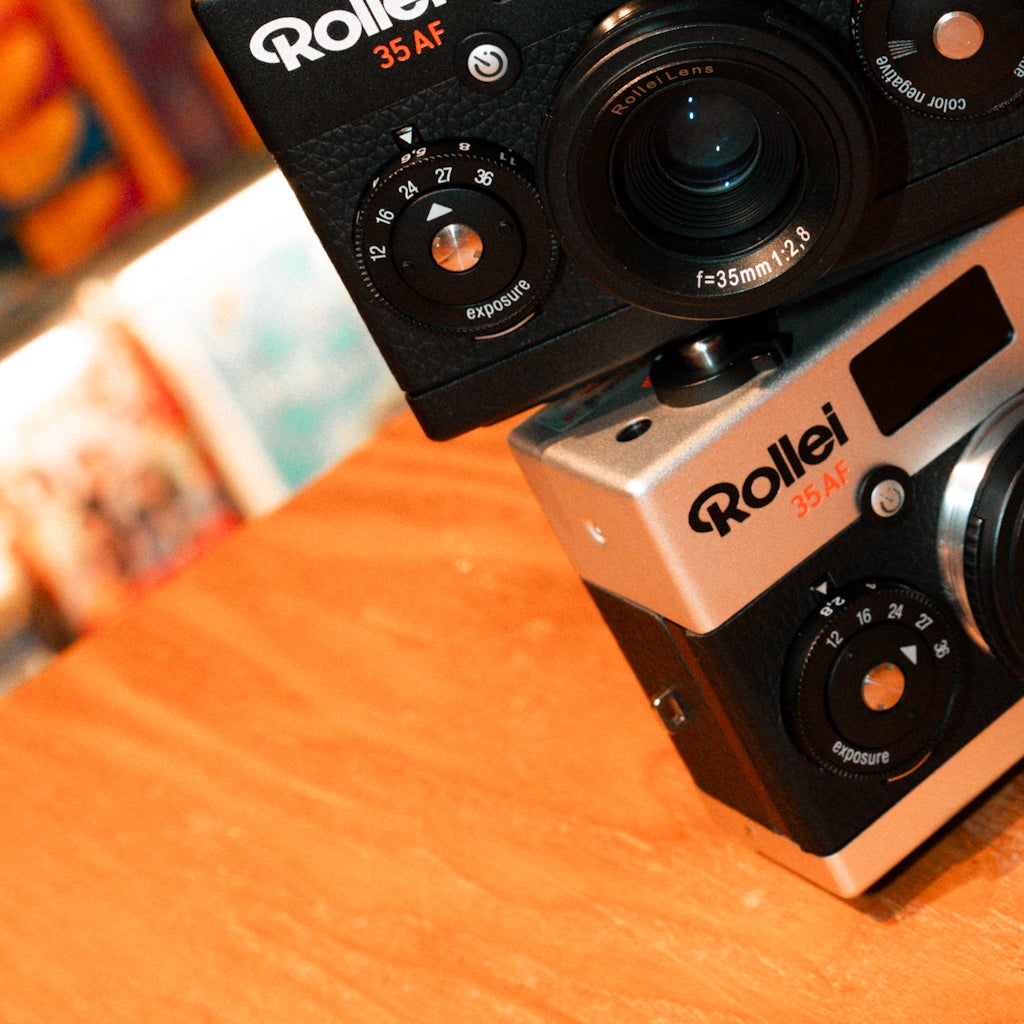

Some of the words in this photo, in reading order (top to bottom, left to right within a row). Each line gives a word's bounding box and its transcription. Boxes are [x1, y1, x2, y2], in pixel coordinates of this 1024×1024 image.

[372, 37, 412, 69] 35
[413, 20, 445, 55] AF
[875, 56, 926, 104] negative
[926, 96, 967, 113] color
[459, 142, 471, 152] 8
[435, 167, 453, 184] 27
[474, 169, 495, 186] 36
[398, 180, 419, 200] 24
[375, 208, 395, 225] 16
[369, 245, 387, 262] 12
[696, 260, 772, 288] f=35mm
[771, 226, 811, 267] 1:2,8
[466, 279, 531, 320] exposure
[688, 401, 849, 537] Rollei
[790, 483, 823, 519] 35
[822, 459, 849, 497] AF
[826, 630, 844, 648] 12
[856, 608, 872, 625] 16
[888, 603, 904, 619] 24
[915, 613, 934, 631] 27
[933, 639, 950, 659] 36
[832, 741, 890, 766] exposure
